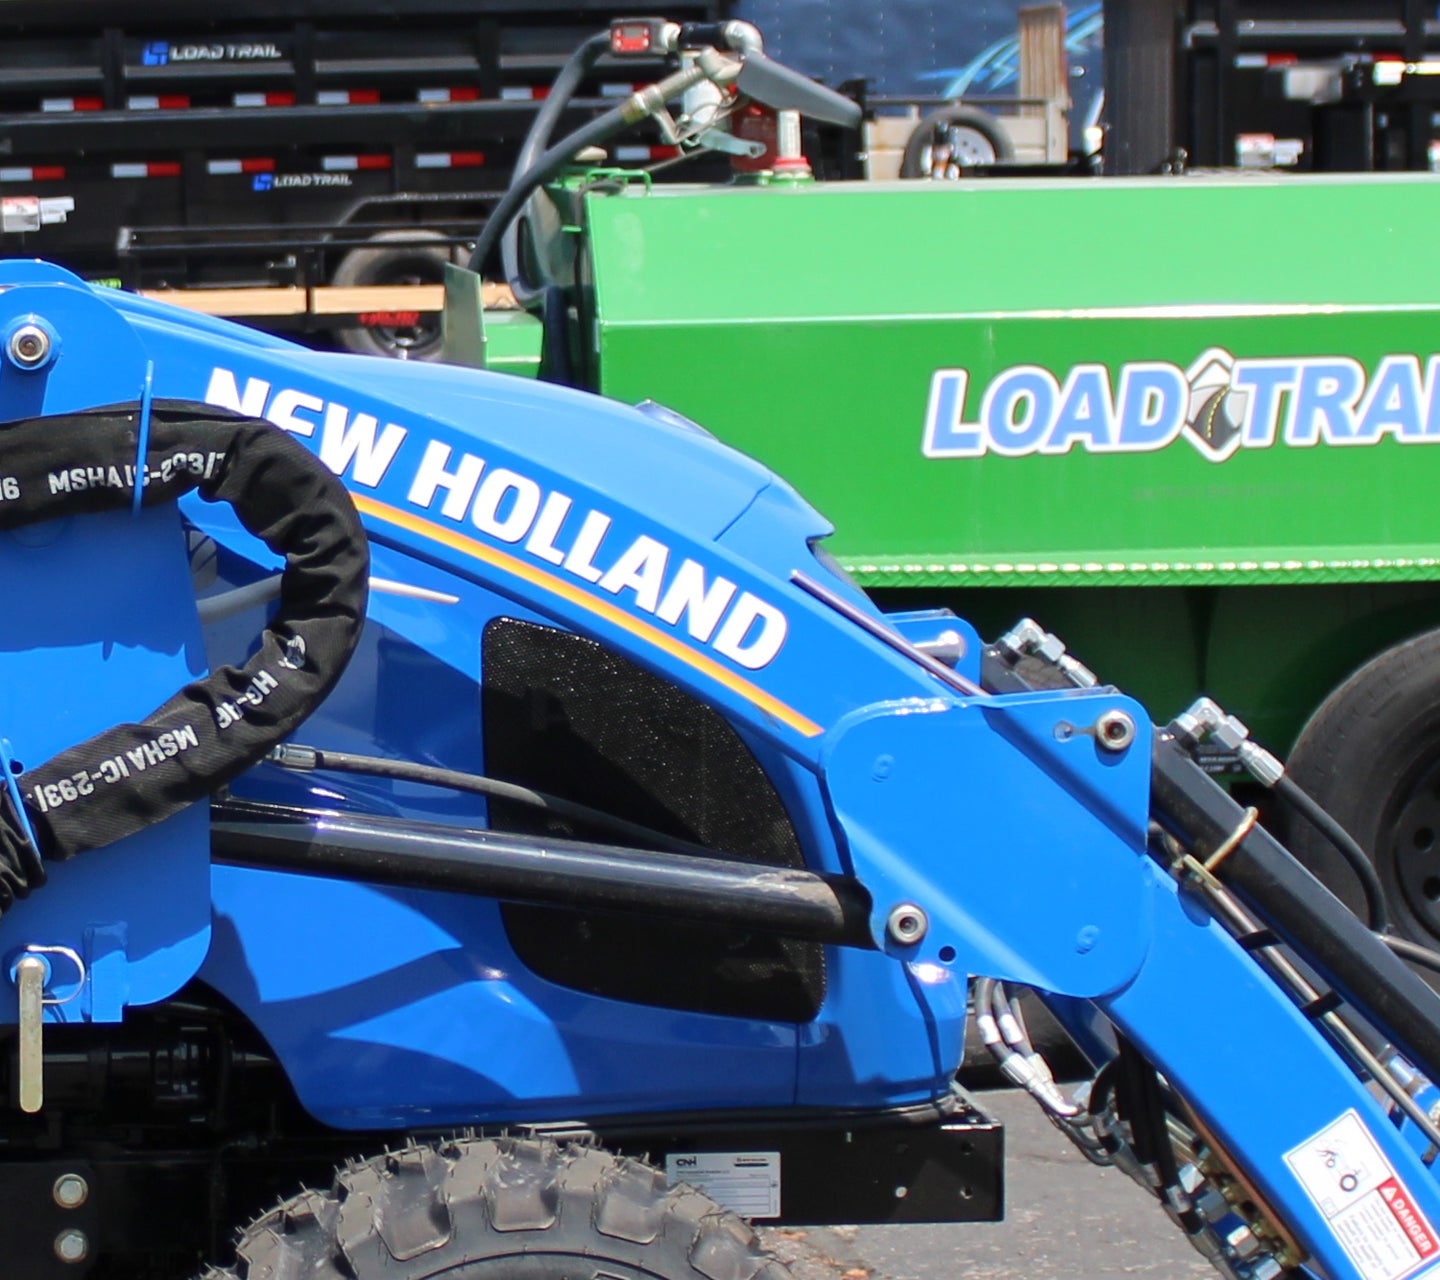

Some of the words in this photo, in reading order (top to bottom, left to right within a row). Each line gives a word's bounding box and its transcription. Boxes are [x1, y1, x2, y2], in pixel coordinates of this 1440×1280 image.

[172, 44, 224, 61] LOAD
[227, 42, 282, 59] TRAIL
[925, 363, 1189, 456] LOAD
[48, 464, 122, 495] MSHA
[407, 439, 788, 672] HOLLAND
[128, 724, 200, 772] MSHA
[1392, 1198, 1433, 1253] DANGER
